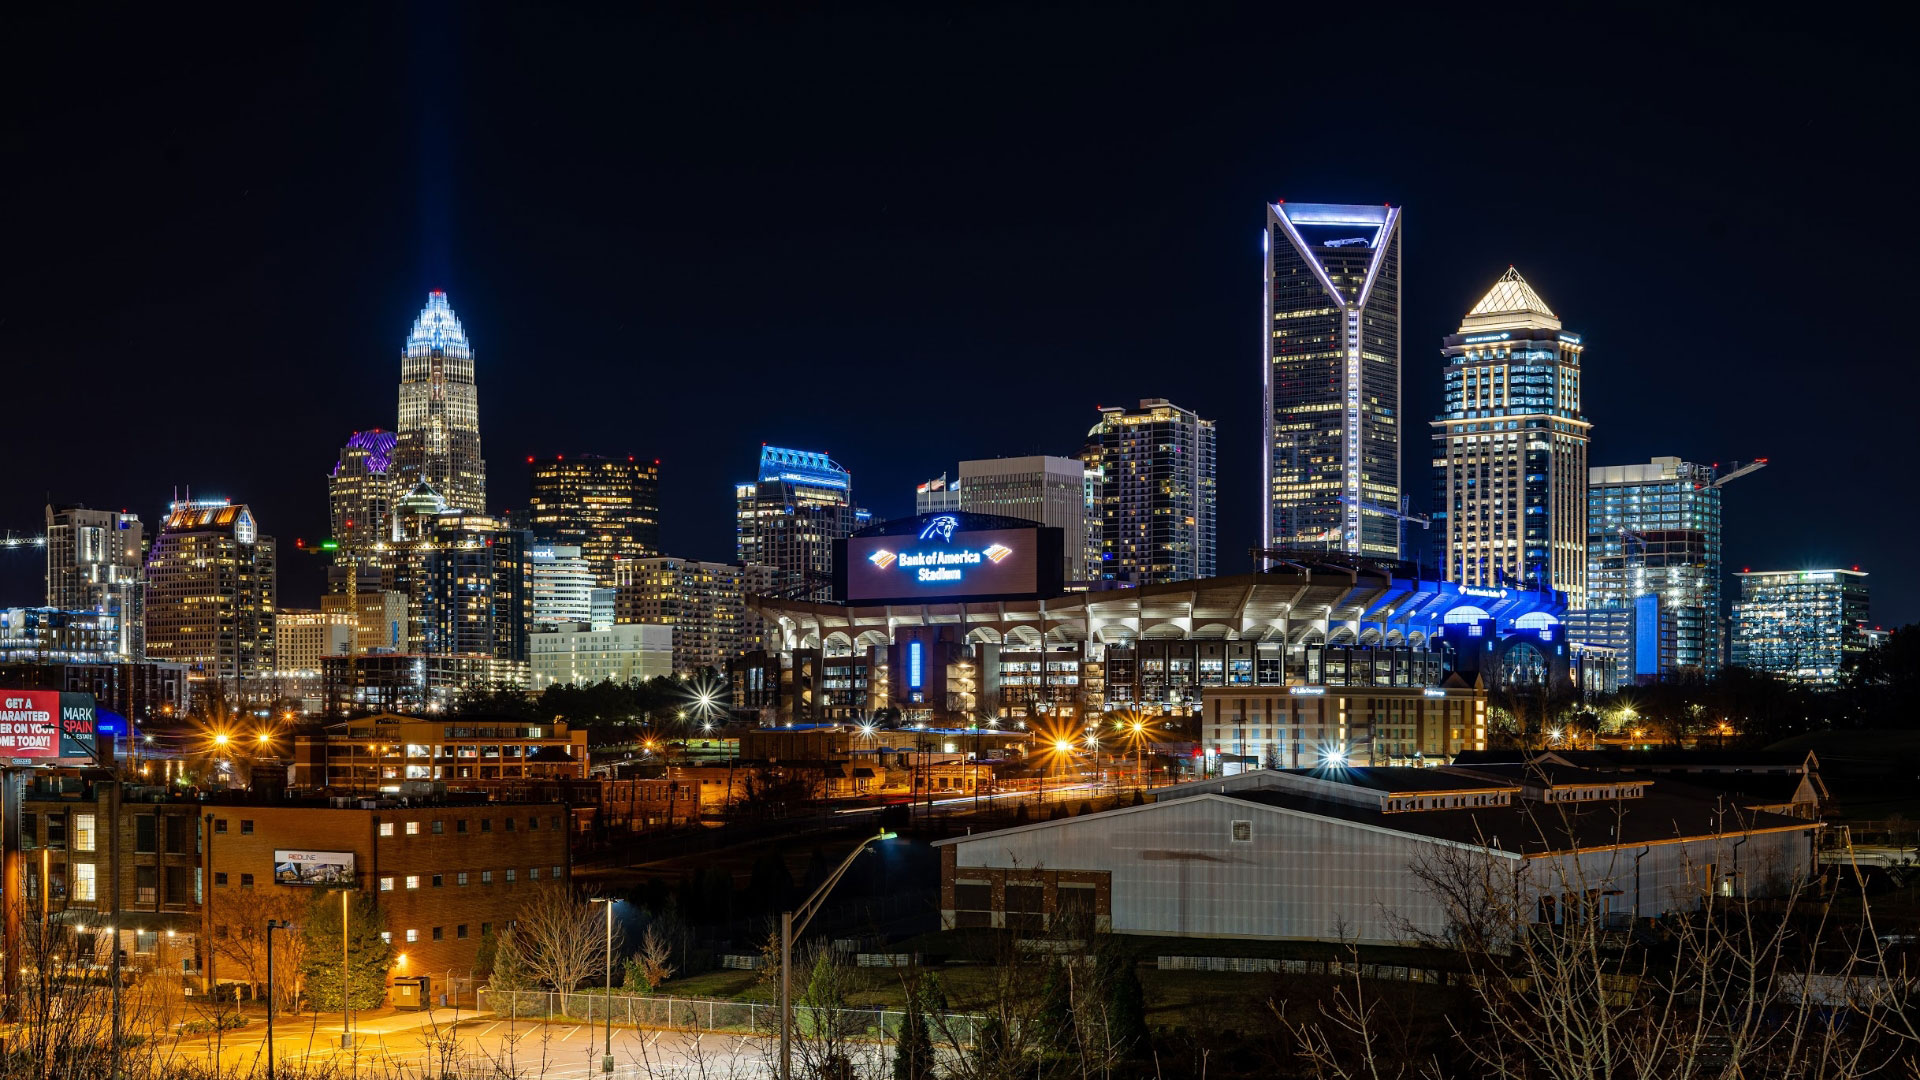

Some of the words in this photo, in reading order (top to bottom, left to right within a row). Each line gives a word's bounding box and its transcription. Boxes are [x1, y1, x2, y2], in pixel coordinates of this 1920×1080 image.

[899, 552, 925, 566] Bank
[925, 551, 937, 565] of
[937, 550, 980, 565] America
[919, 567, 960, 581] Stadium
[5, 698, 24, 709] GET
[25, 698, 33, 709] A
[63, 707, 93, 720] MARK
[0, 723, 13, 734] ER
[13, 723, 28, 734] ON
[30, 723, 55, 734] YOUR
[63, 720, 93, 733] SPAIN
[17, 735, 50, 746] TODAY!
[288, 853, 316, 861] REDLINE
